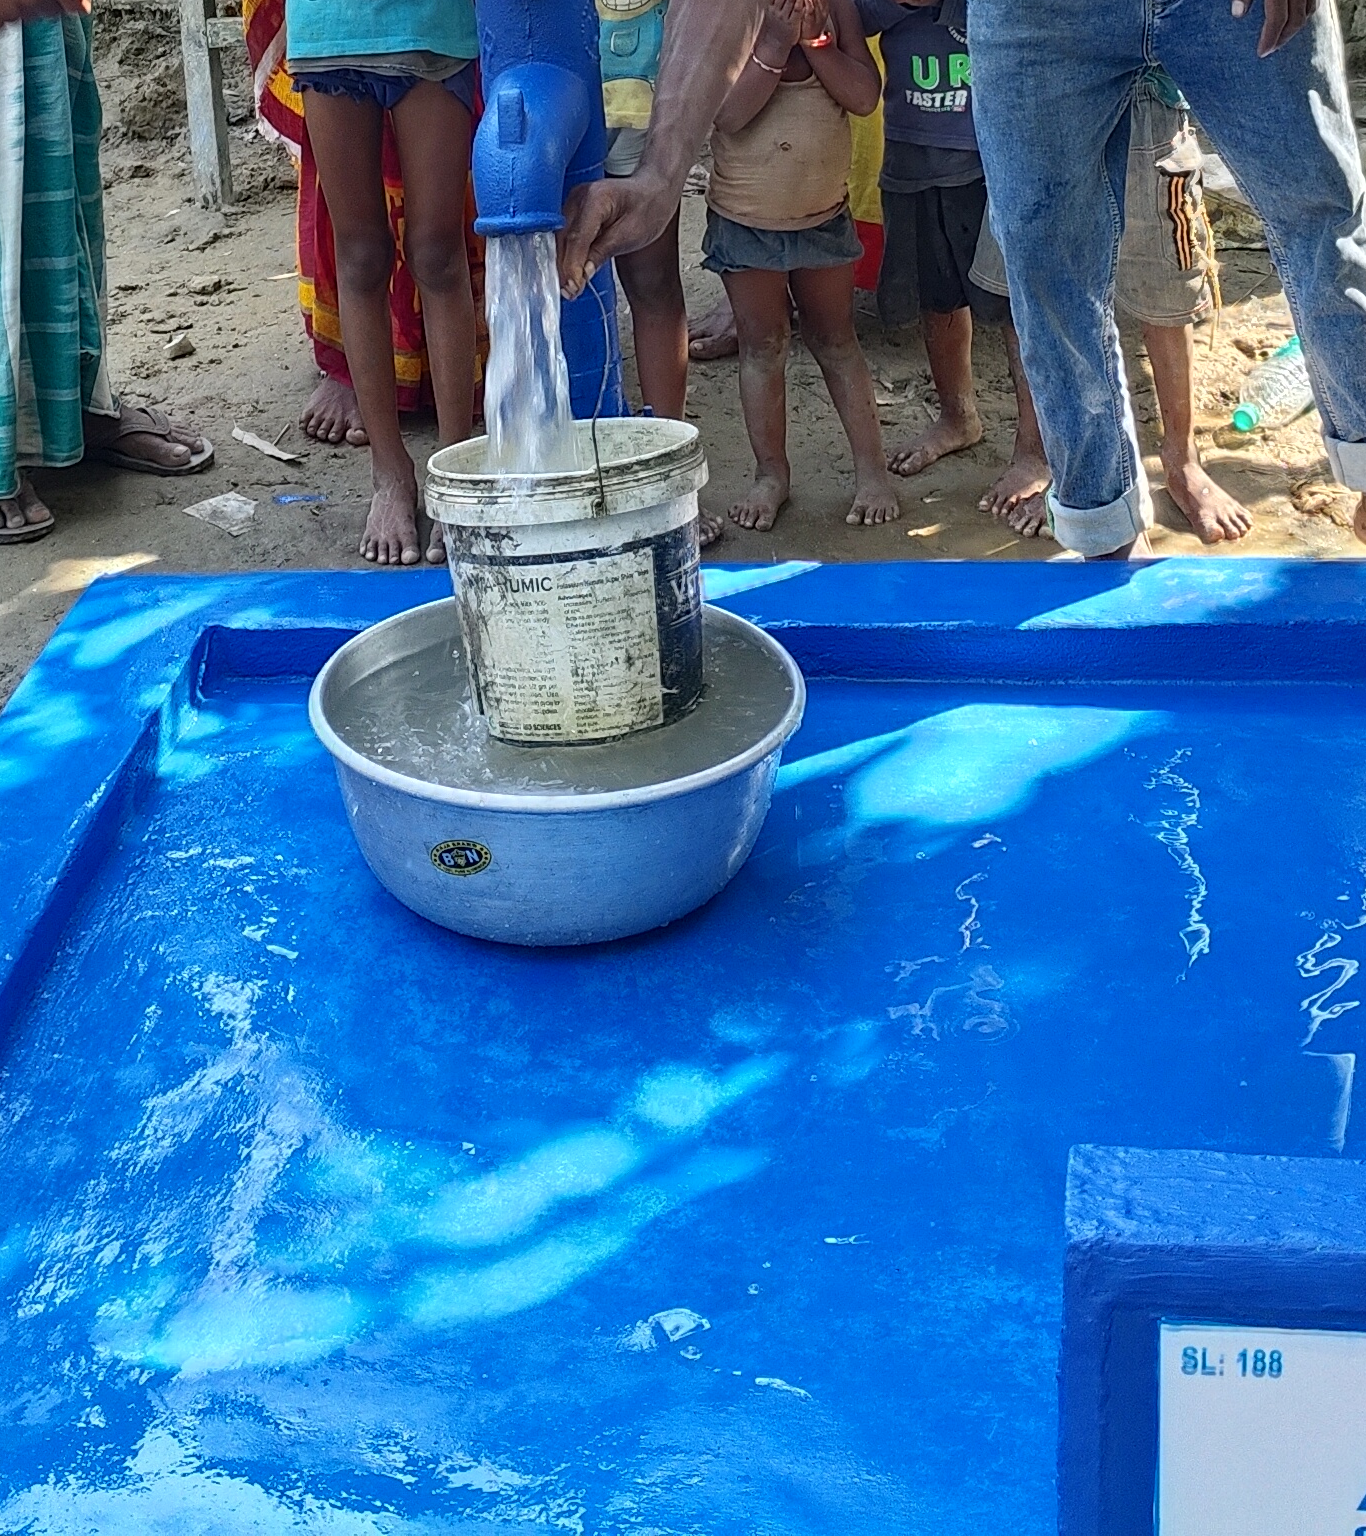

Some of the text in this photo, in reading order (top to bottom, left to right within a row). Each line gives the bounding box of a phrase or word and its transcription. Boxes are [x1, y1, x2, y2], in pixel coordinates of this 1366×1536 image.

[905, 90, 968, 107] FASTER
[441, 848, 480, 866] B N
[1180, 1345, 1283, 1379] SL: 188
